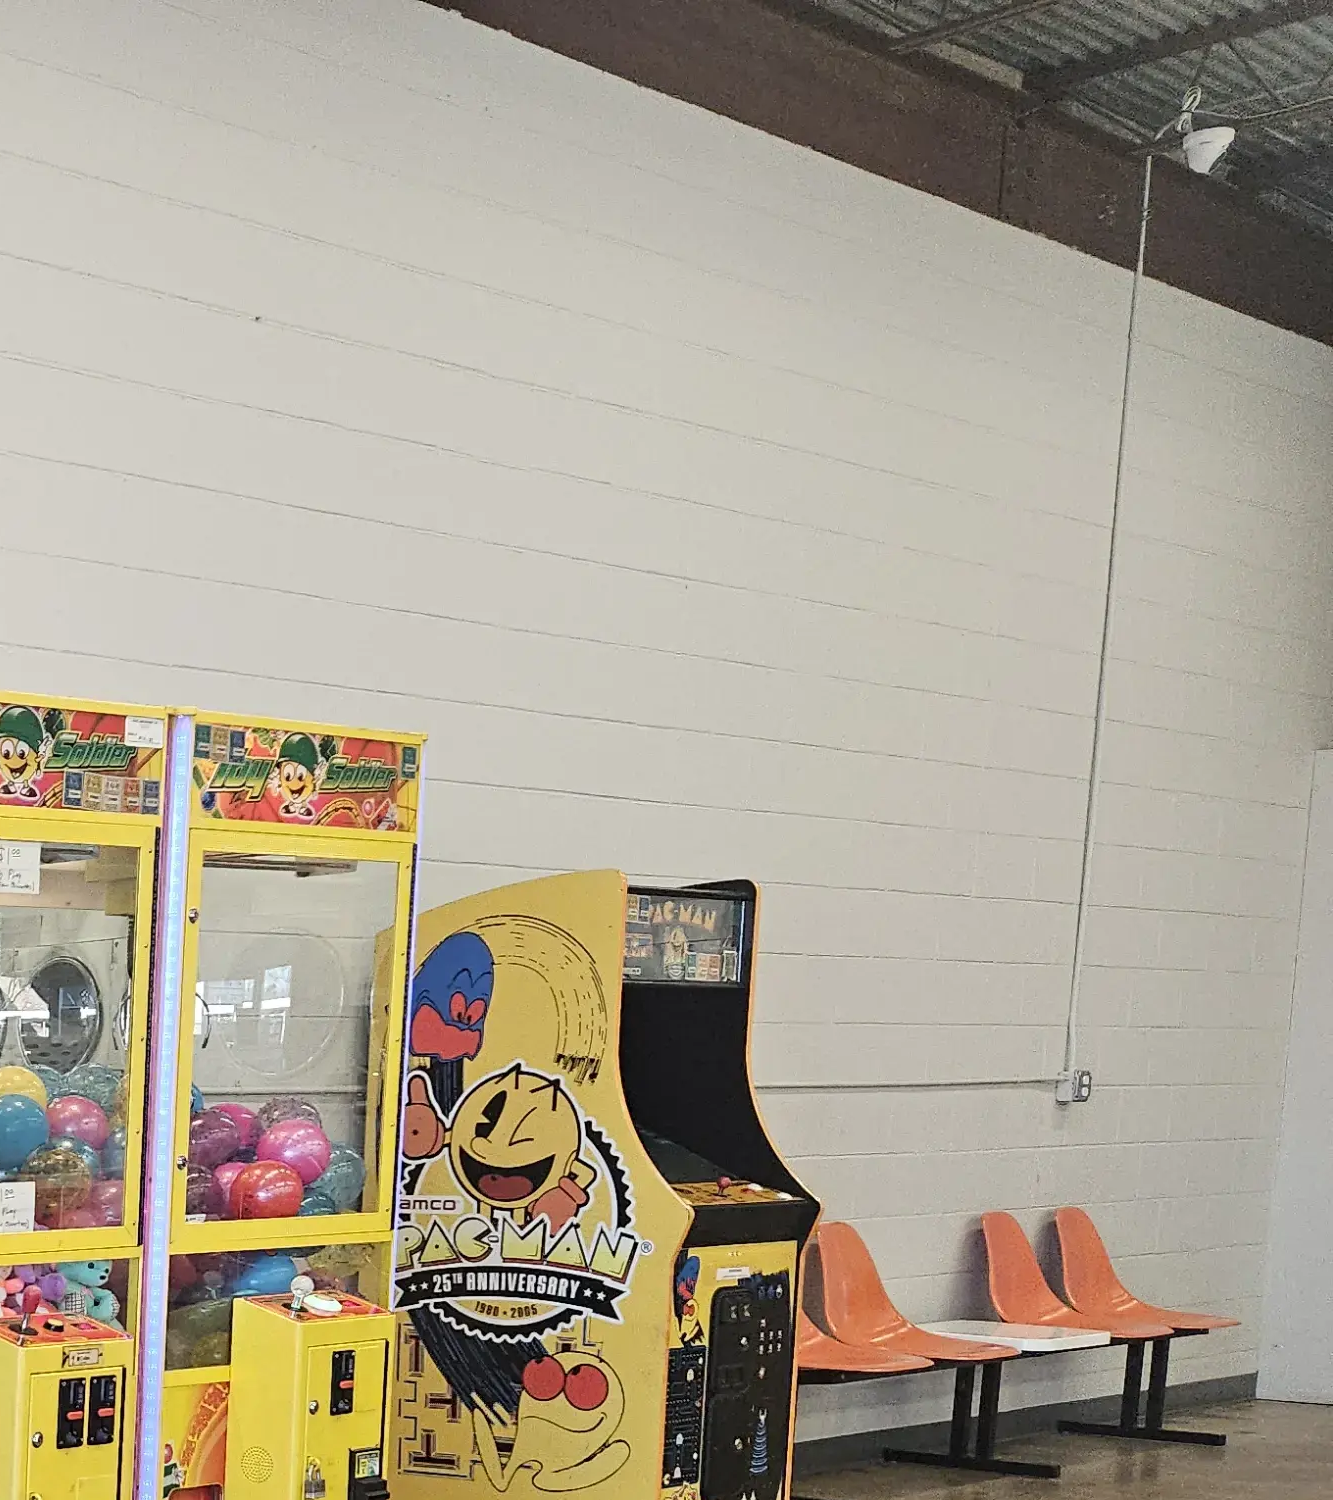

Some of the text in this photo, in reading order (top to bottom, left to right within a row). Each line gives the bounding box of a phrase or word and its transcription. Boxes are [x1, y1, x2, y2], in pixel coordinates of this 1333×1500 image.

[45, 732, 136, 771] Soldier
[319, 754, 397, 792] Soldier
[399, 1199, 456, 1210] amco
[396, 1216, 638, 1284] PAC-MAN
[433, 1272, 581, 1299] 25TH ANNIVERSARY
[475, 1301, 538, 1318] 1980 2005
